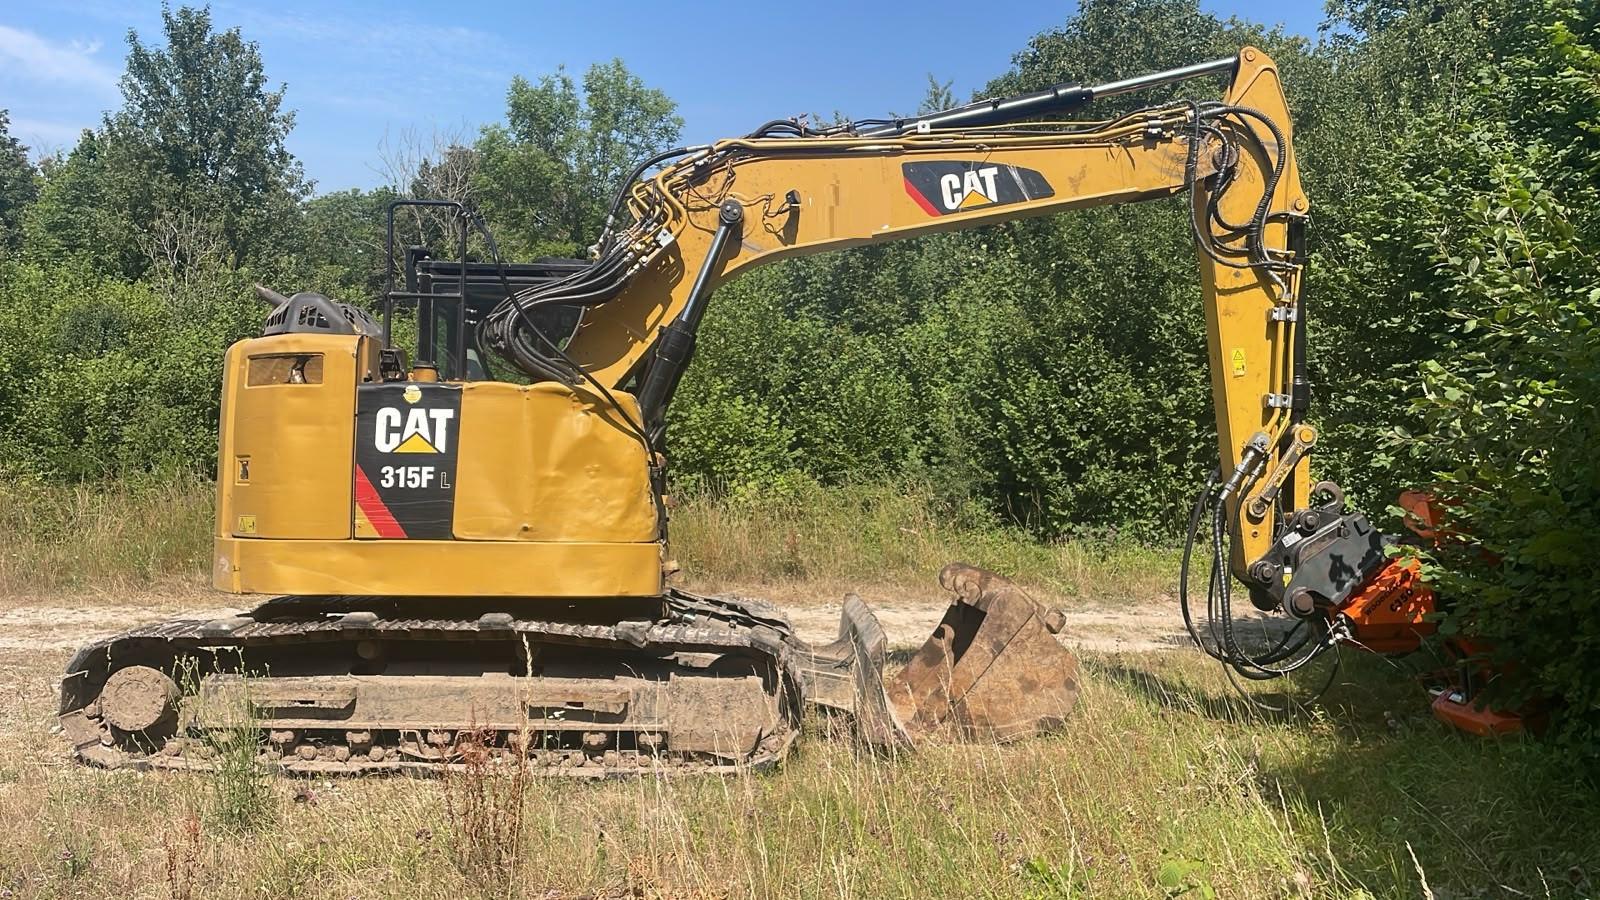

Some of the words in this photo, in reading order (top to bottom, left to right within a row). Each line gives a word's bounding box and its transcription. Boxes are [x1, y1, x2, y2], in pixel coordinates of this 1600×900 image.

[940, 167, 998, 209] CAT
[375, 407, 454, 453] CAT
[380, 465, 435, 488] 315F
[440, 472, 450, 489] L
